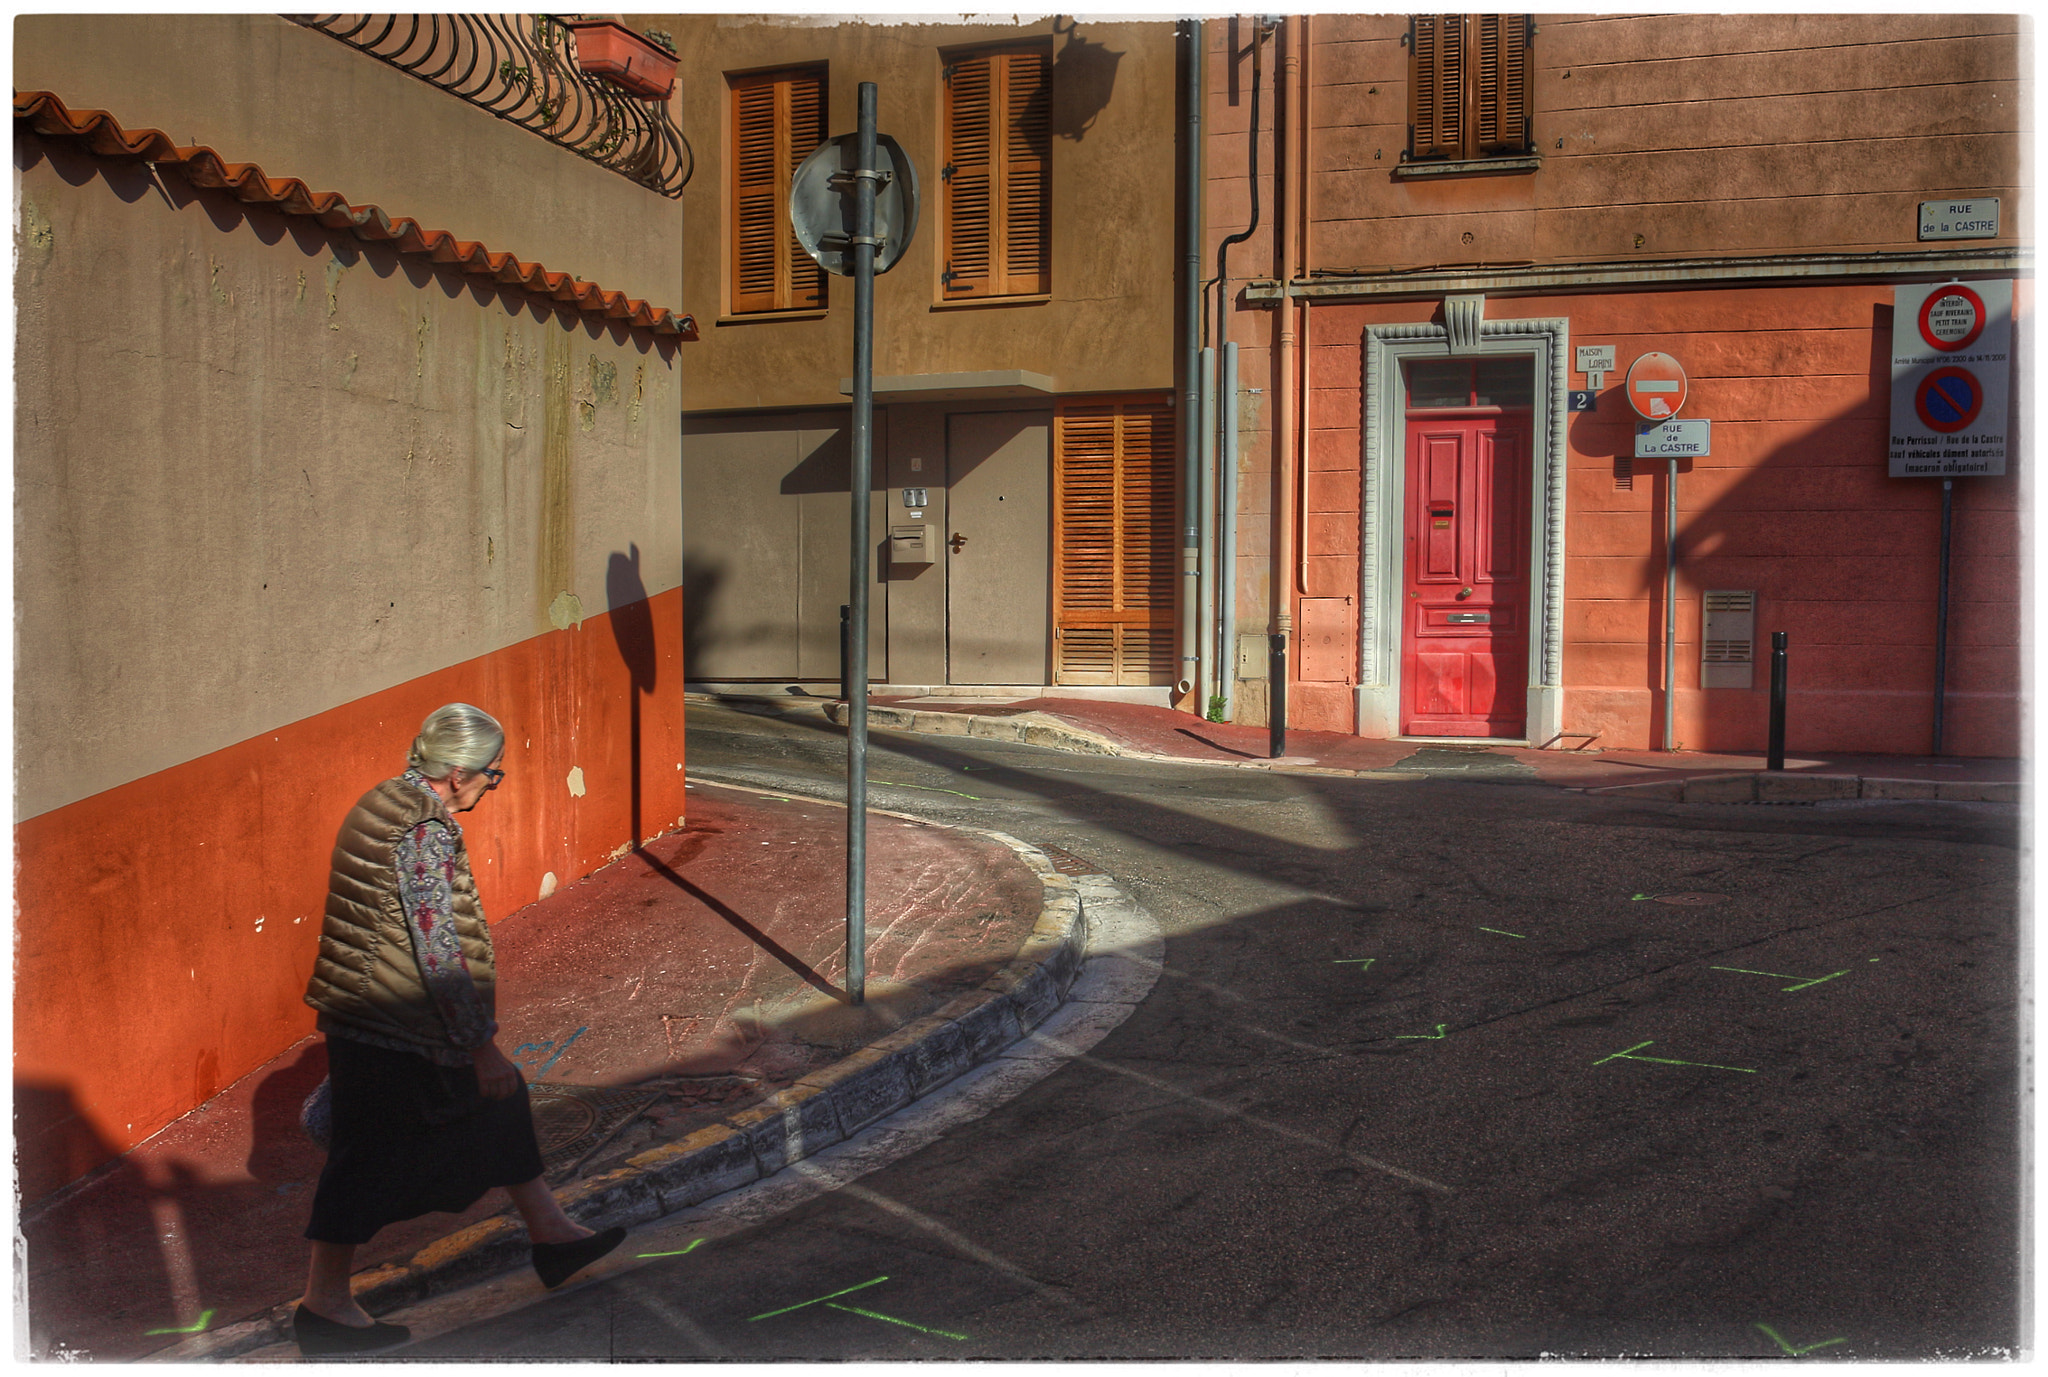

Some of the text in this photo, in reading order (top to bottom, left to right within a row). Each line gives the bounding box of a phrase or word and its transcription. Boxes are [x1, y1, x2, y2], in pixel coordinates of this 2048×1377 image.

[1949, 204, 1972, 214] RUE
[1923, 220, 1994, 233] de la CASTRE
[1936, 328, 1965, 336] CEREMONIE
[1580, 348, 1602, 357] MAISON
[1588, 359, 1612, 369] LORINI
[1592, 373, 1598, 387] 1
[1576, 392, 1587, 409] 2
[1662, 425, 1682, 433] RUE
[1666, 434, 1678, 442] de
[1891, 436, 1904, 445] Rue
[1907, 435, 1938, 445] Perrissol
[1946, 435, 1959, 444] Rue
[1961, 434, 1970, 444] de
[1972, 434, 1979, 443] la
[1981, 434, 2004, 443] Castre
[1644, 443, 1700, 453] La CASTRE
[1890, 450, 1905, 459] sauf
[1908, 449, 1940, 458] véhicules
[1905, 462, 1988, 473] (macaron obligatoire)
